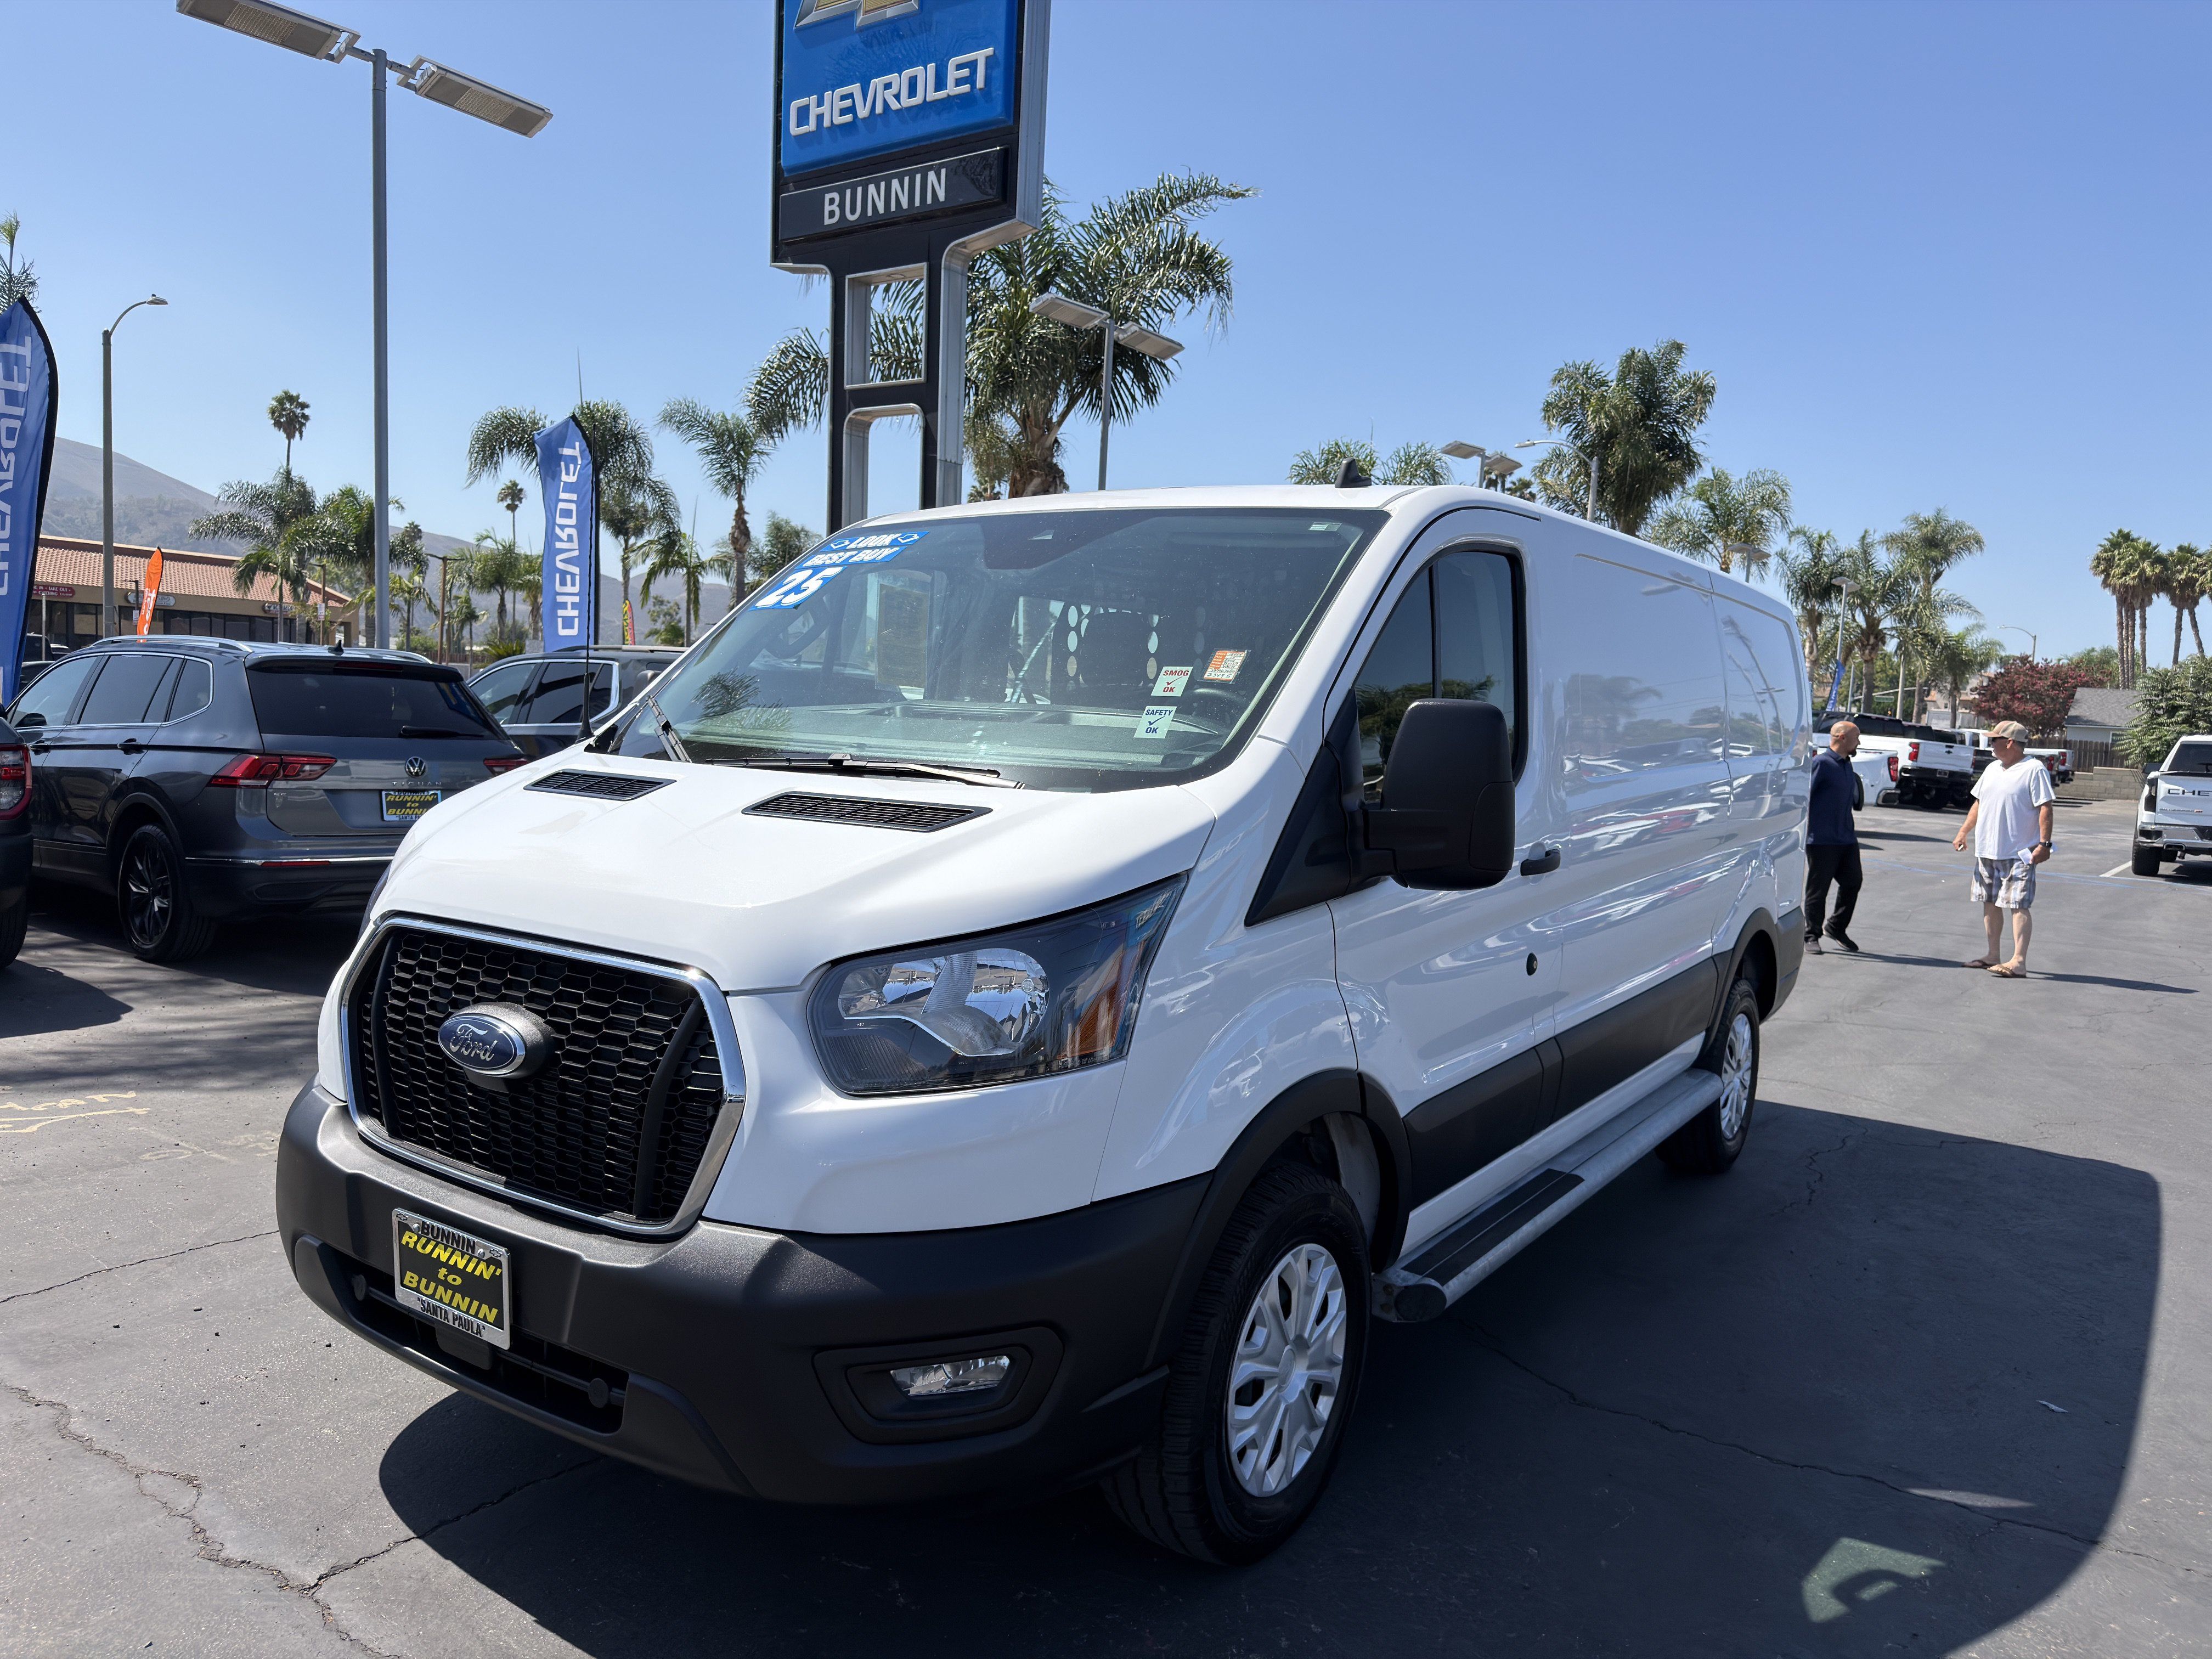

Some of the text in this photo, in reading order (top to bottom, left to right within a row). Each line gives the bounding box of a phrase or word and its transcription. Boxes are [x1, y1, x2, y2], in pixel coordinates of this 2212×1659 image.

[789, 47, 994, 137] CHEVROLET
[823, 168, 946, 225] BUNNIN
[802, 547, 900, 567] BEST BUY
[847, 533, 902, 549] LOOK
[755, 567, 843, 608] 25
[449, 1023, 498, 1061] Ford
[401, 1230, 503, 1280] RUNNIN'
[420, 1221, 477, 1255] BUNNIN
[437, 1267, 462, 1285] to
[403, 1271, 499, 1324] BUNNIN
